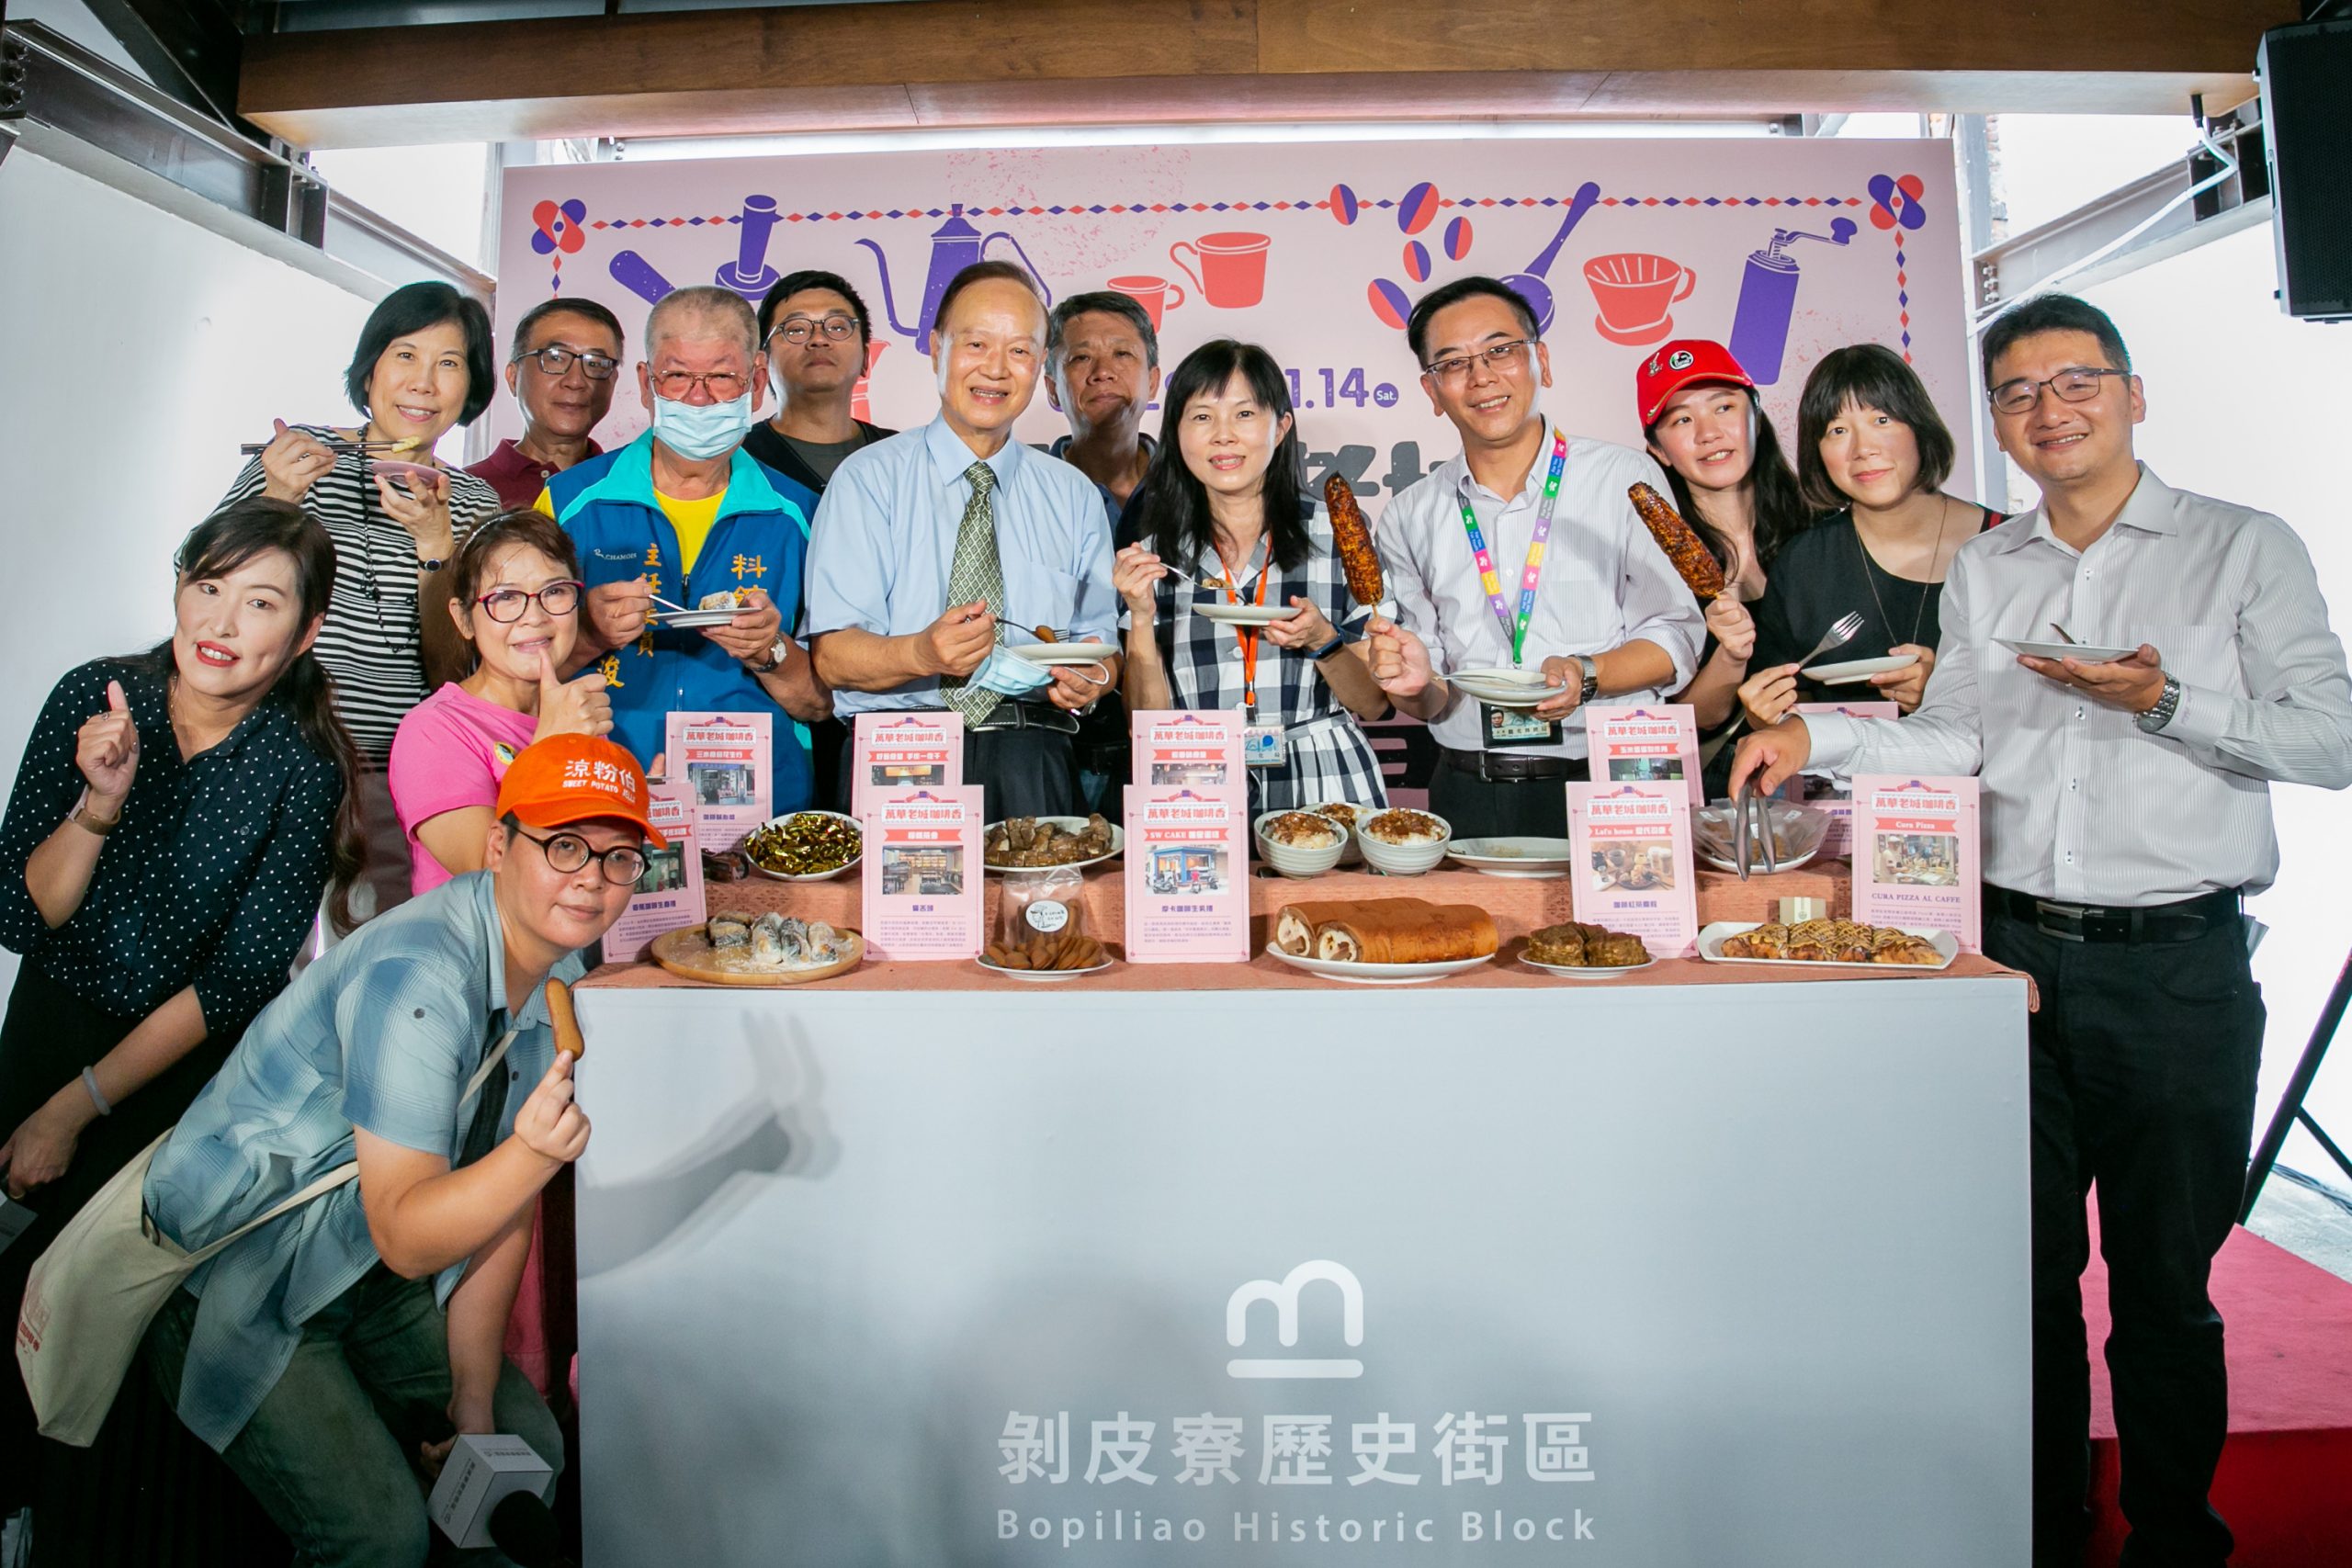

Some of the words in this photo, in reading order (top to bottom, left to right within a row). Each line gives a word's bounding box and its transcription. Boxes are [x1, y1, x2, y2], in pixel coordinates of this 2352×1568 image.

[1376, 389, 1397, 401] Sat.
[563, 759, 636, 793] 涼粉伯
[562, 779, 588, 788] SWEET
[591, 780, 618, 794] POTATO
[1895, 820, 1914, 829] Cura
[1916, 821, 1936, 829] Pizza
[1871, 892, 1894, 900] CURA
[1896, 893, 1919, 901] PIZZA
[1935, 896, 1962, 904] CAFFE
[997, 1410, 1597, 1486] 剝皮寮歷史街區
[997, 1509, 1206, 1548] Bopiliao
[1234, 1511, 1434, 1543] Historic
[1462, 1508, 1596, 1543] Block
